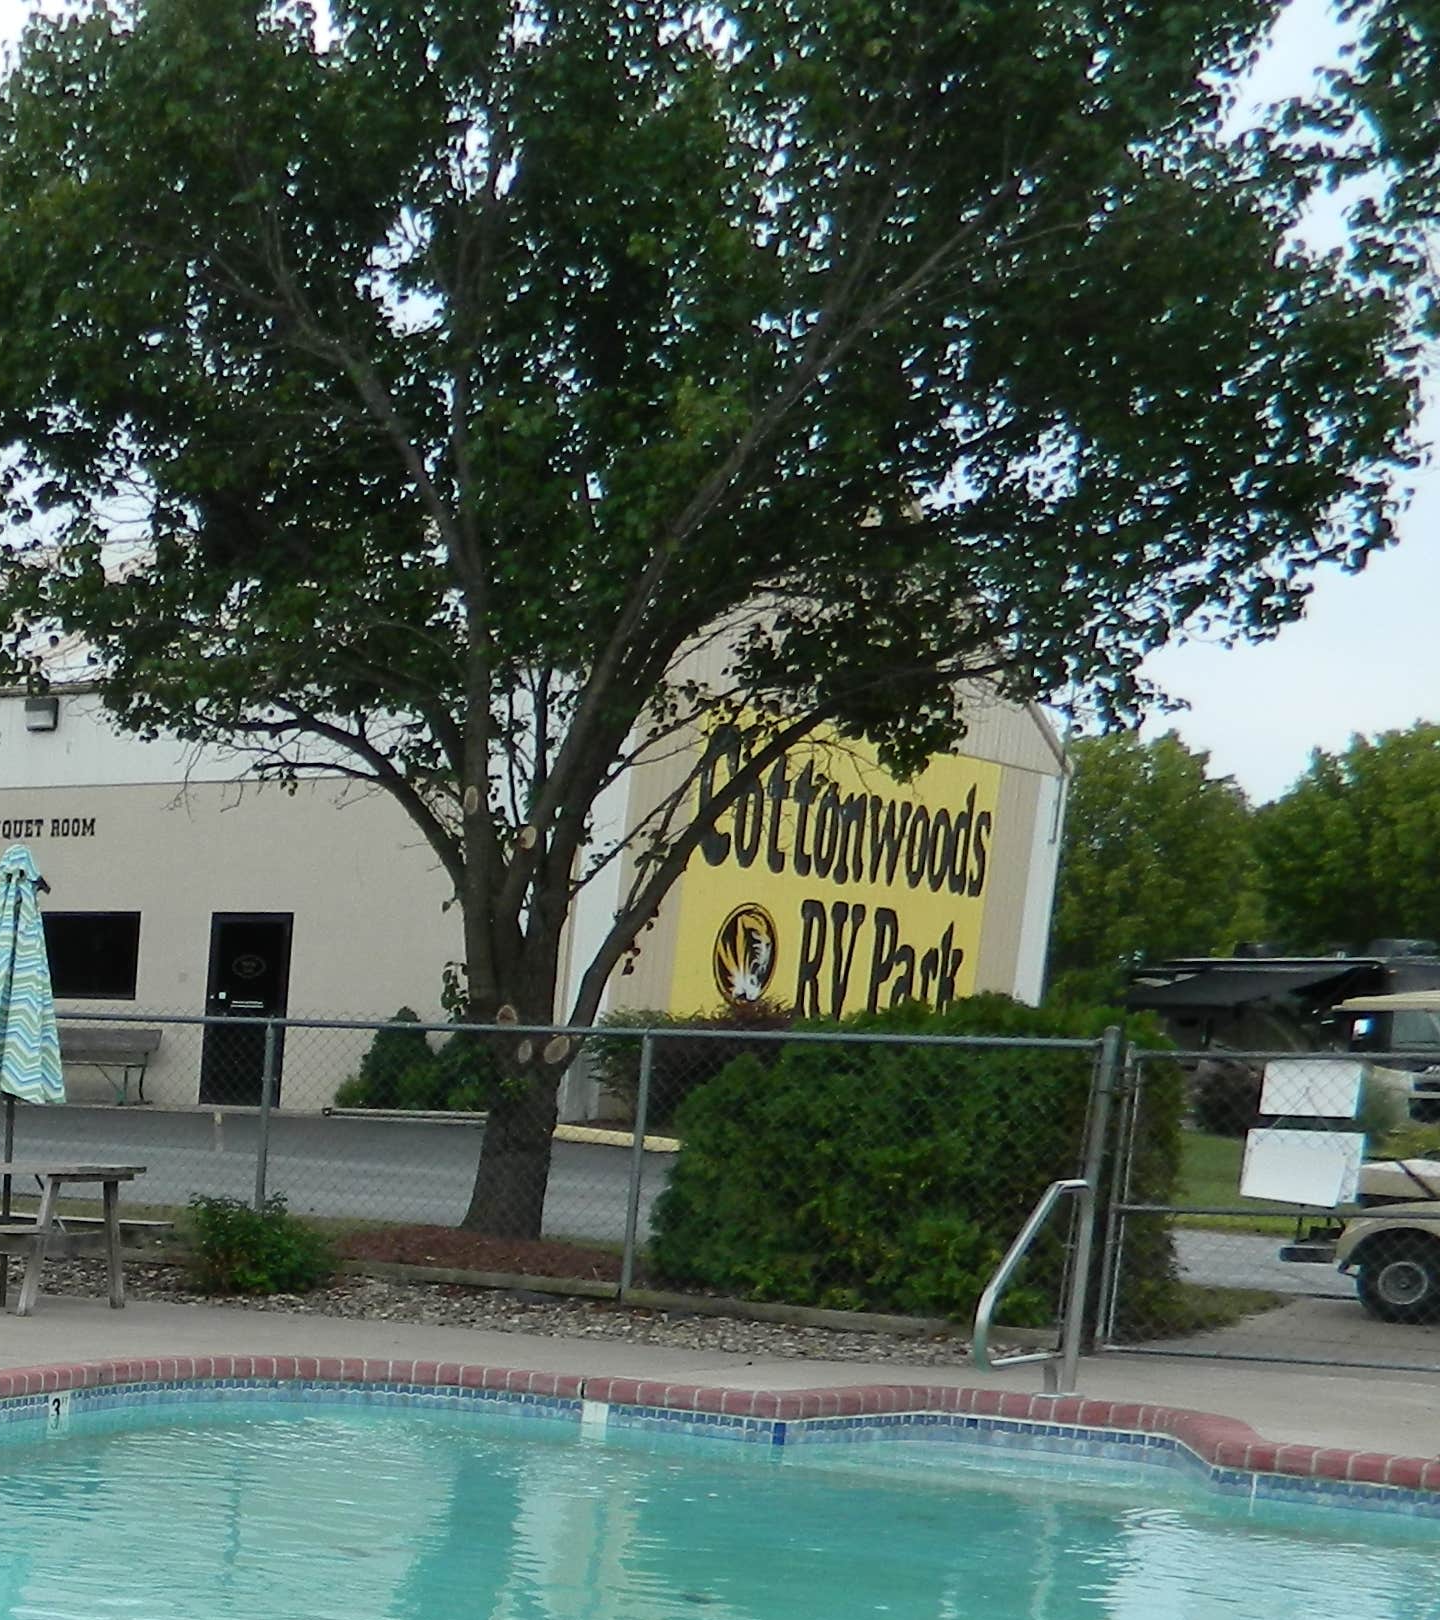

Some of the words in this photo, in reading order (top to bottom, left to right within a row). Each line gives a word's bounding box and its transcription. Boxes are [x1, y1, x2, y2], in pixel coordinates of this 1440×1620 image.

[50, 817, 96, 837] ROOM
[699, 723, 991, 897] Cottonwoods
[794, 899, 866, 1021] RV
[867, 907, 964, 1016] Park
[51, 1398, 61, 1416] 3
